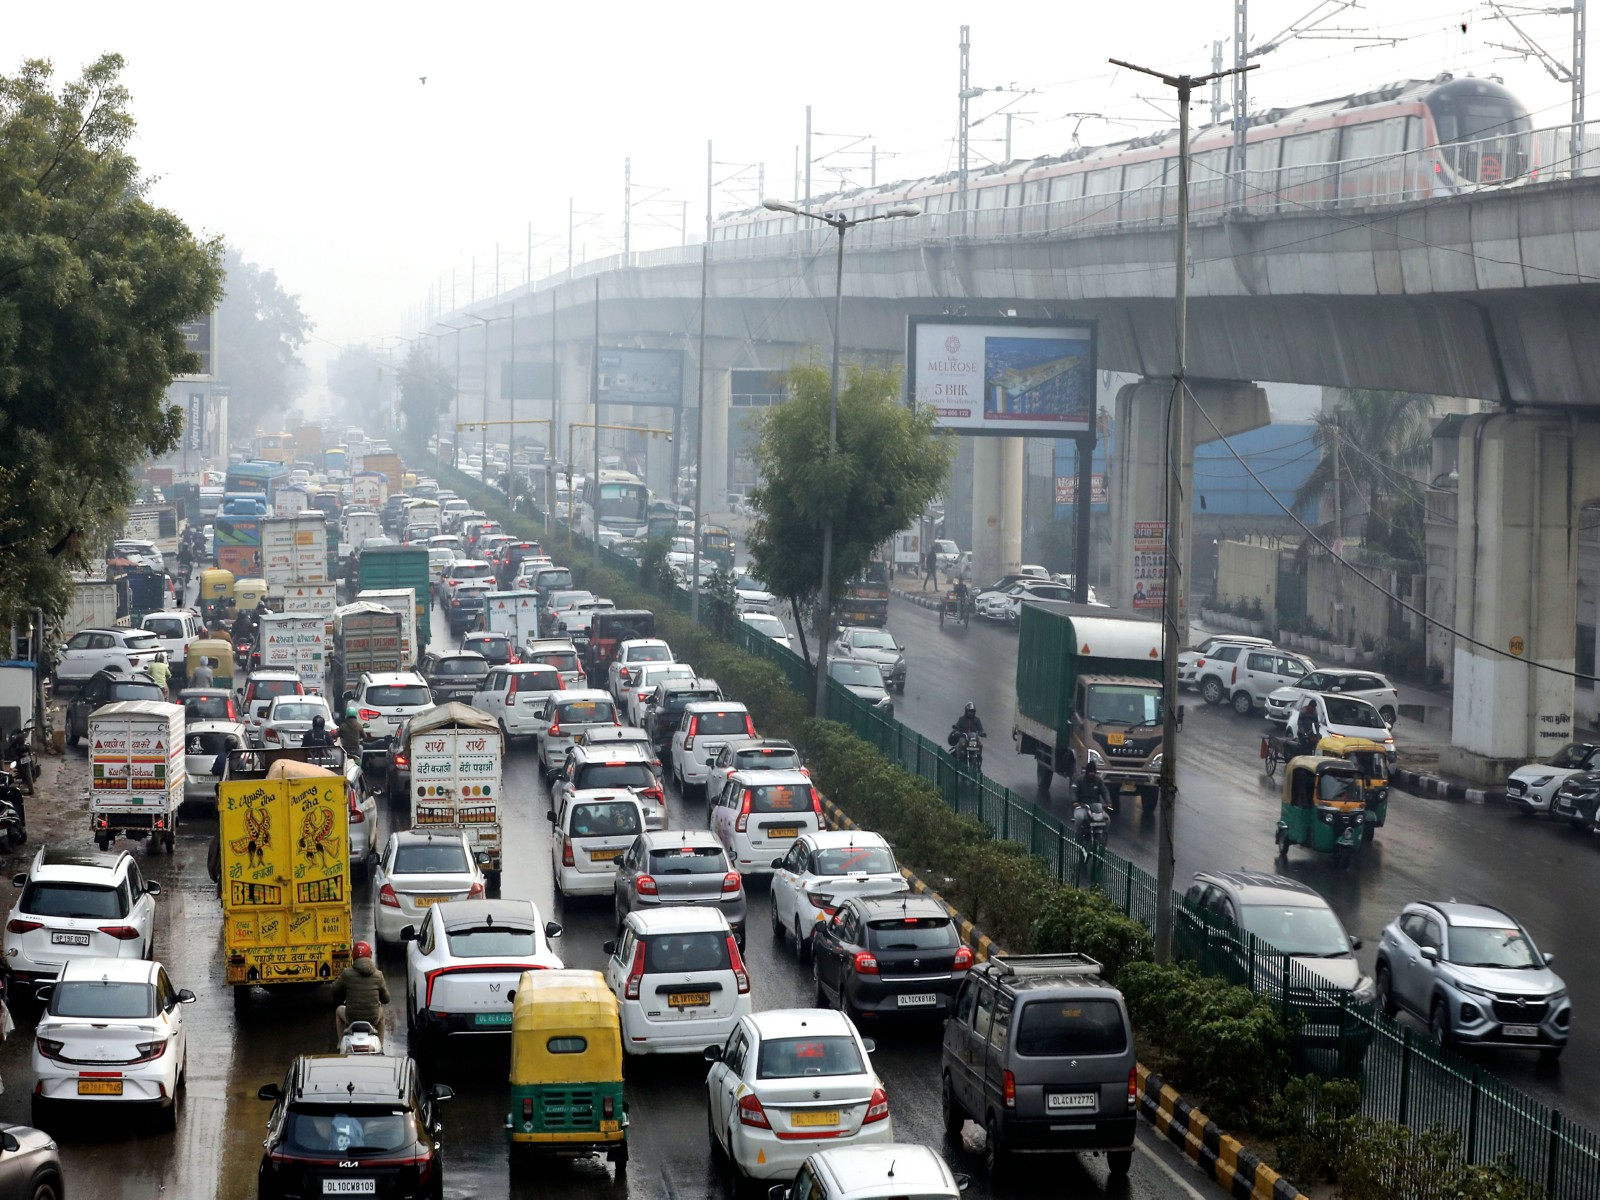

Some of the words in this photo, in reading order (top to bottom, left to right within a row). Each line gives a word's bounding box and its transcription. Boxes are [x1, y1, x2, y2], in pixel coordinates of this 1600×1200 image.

[928, 361, 977, 373] MELROSE
[934, 383, 943, 396] 5
[945, 383, 968, 396] BHK
[301, 663, 319, 672] HORN
[459, 761, 471, 773] बेटी
[459, 806, 496, 823] HORN
[232, 881, 281, 905] BLOW
[298, 876, 342, 902] HORN
[327, 1182, 374, 1191] DL10CW8109
